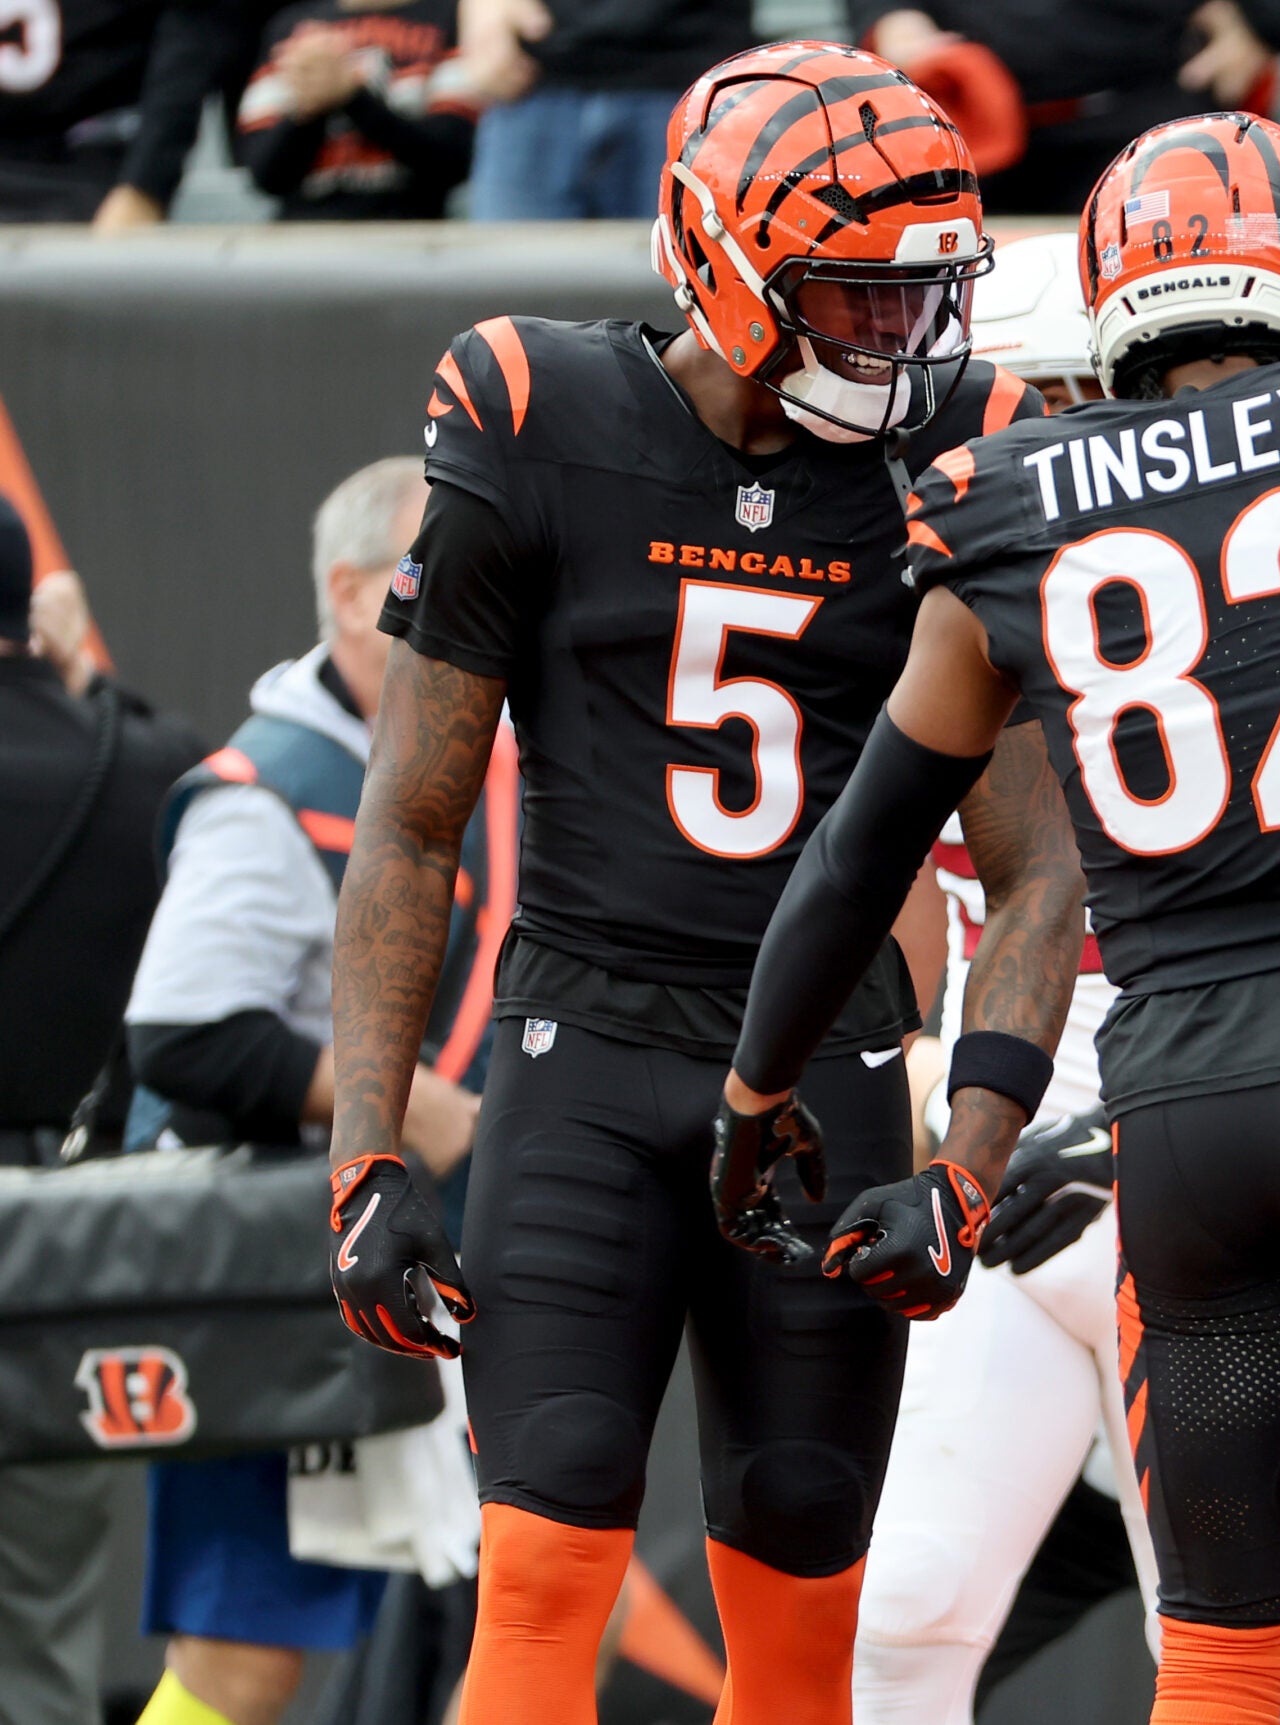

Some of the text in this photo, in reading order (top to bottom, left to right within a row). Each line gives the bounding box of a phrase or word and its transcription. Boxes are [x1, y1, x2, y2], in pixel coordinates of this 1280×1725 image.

[1137, 276, 1231, 300] BENGALS
[742, 504, 767, 522] NFL
[648, 541, 851, 583] BENGALS
[394, 572, 416, 595] NFL
[666, 577, 825, 860] 5
[527, 1032, 548, 1049] NFL
